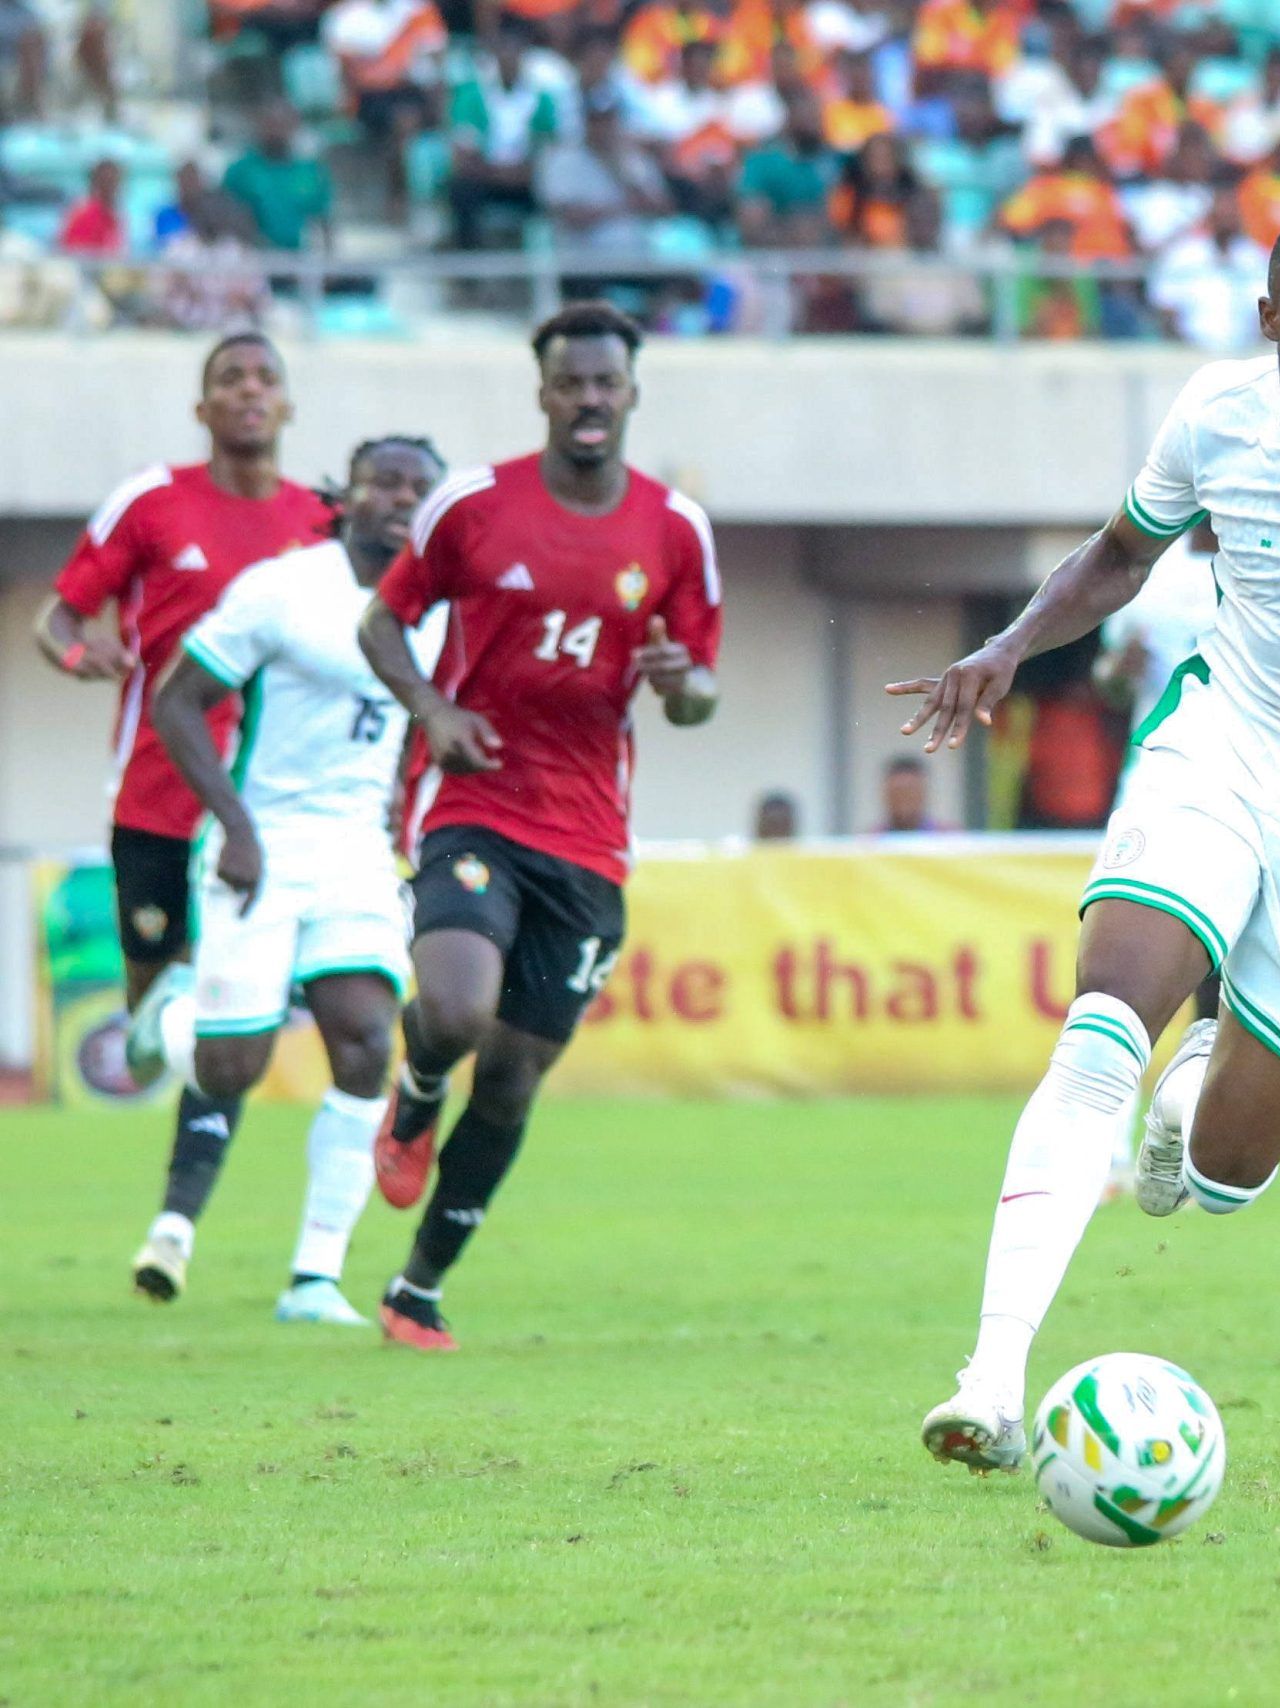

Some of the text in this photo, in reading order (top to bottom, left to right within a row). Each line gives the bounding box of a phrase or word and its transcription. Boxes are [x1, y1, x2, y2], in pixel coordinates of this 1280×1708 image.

[534, 609, 602, 669] 14
[350, 694, 397, 743] 15
[773, 938, 982, 1020] that
